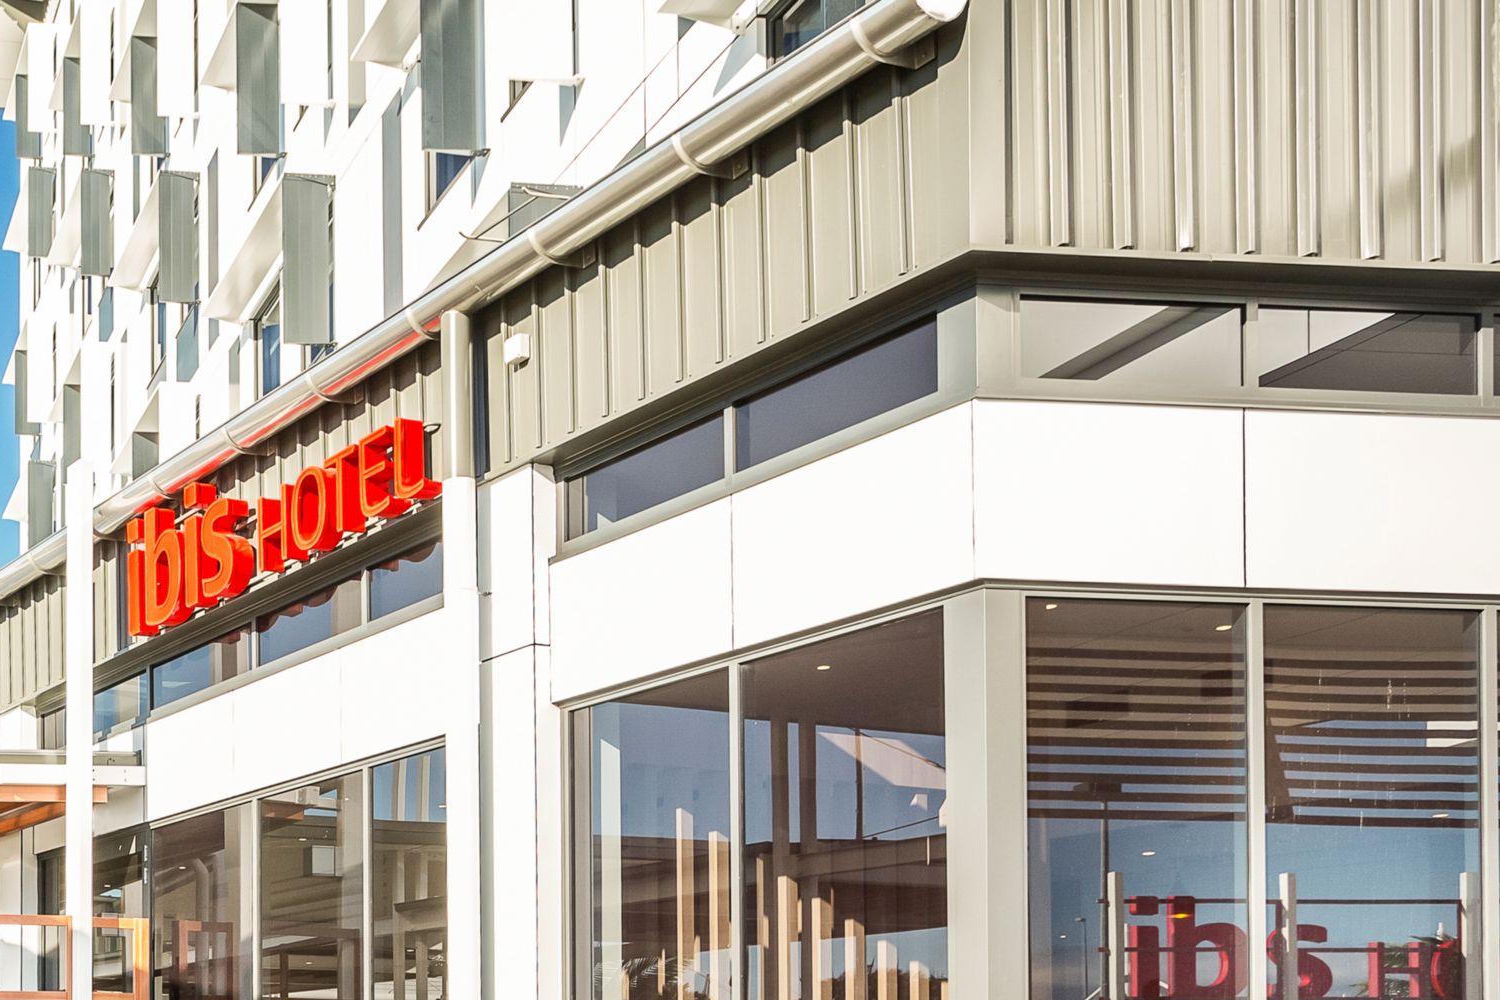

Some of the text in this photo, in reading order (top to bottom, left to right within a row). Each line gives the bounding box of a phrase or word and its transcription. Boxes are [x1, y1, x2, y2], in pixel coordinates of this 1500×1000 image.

[126, 417, 442, 636] ibis HOTEL
[1129, 896, 1333, 1000] ibs
